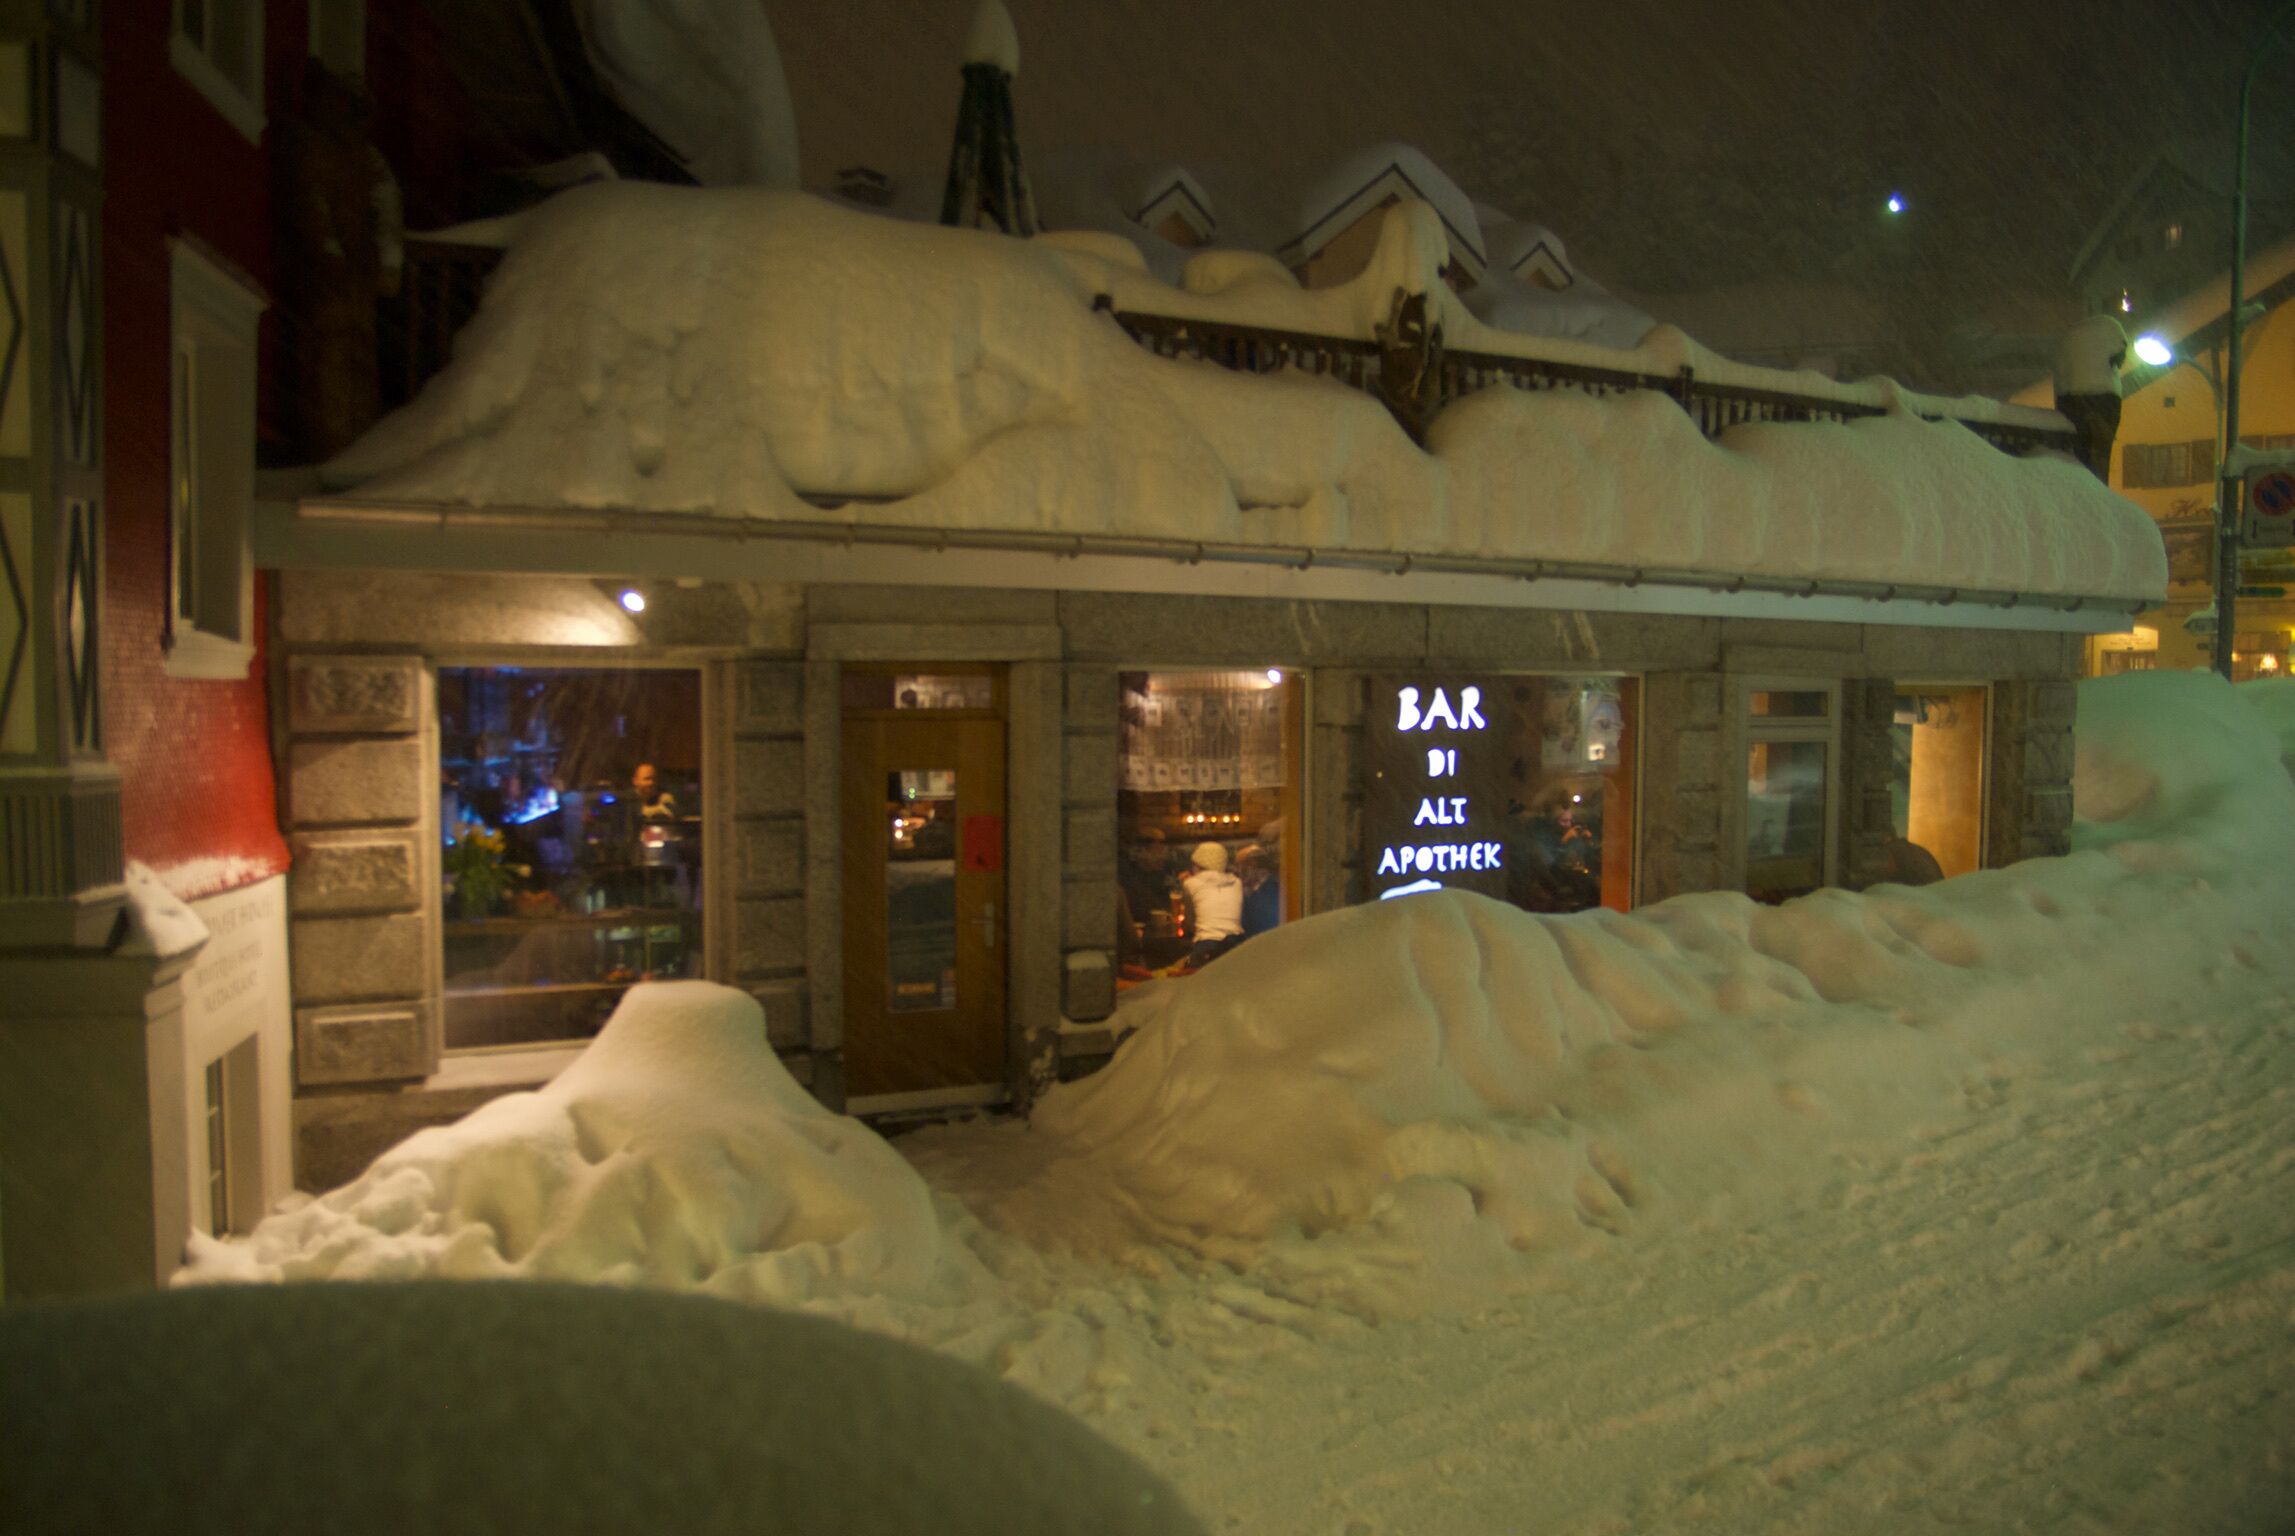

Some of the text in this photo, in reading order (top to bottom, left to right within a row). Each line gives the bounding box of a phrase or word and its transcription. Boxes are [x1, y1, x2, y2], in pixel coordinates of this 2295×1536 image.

[1397, 686, 1486, 731] BAR
[1427, 748, 1456, 778] DI
[1413, 796, 1468, 826] ALT
[1377, 842, 1501, 875] APOTHEK
